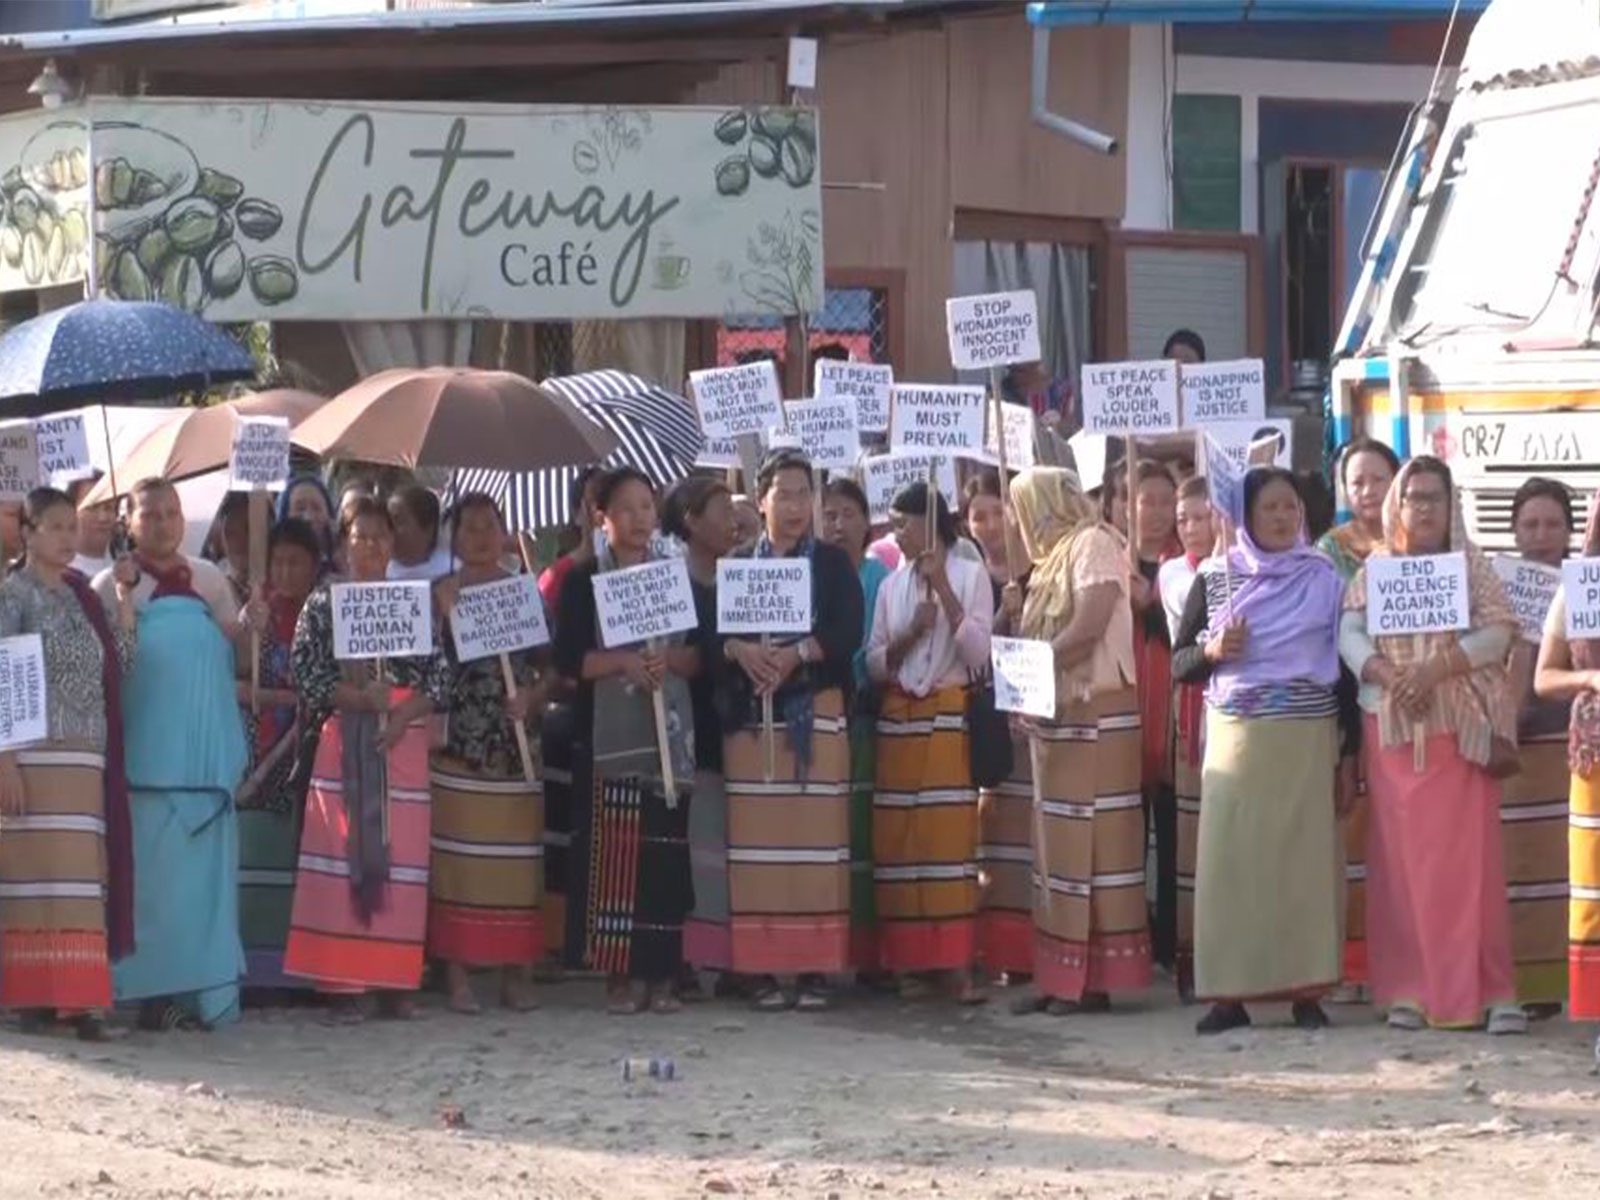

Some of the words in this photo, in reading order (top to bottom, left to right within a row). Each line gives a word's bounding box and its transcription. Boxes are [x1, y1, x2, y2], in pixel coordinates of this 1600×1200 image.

[297, 114, 680, 311] Gateway
[500, 242, 598, 287] Café
[973, 301, 1011, 318] STOP
[954, 314, 1033, 335] KIDNAPPING
[962, 328, 1026, 347] INNOCENT
[970, 343, 1020, 361] PEOPLE
[703, 366, 762, 384] INNOCENT
[822, 367, 845, 379] LET
[848, 369, 889, 384] PEACE
[1091, 370, 1115, 386] LET
[1121, 368, 1166, 384] PEACE
[1180, 371, 1261, 388] KIDNAPPING
[702, 382, 734, 399] LIVES
[738, 377, 768, 391] MUST
[835, 382, 875, 396] SPEAK
[1107, 385, 1153, 399] SPEAK
[1199, 390, 1213, 401] IS
[1215, 387, 1242, 401] NOT
[717, 396, 740, 408] NOT
[897, 391, 981, 406] HUMANITY
[1102, 398, 1159, 414] LOUDER
[704, 403, 777, 424] BARGAINING
[788, 406, 845, 421] OSTAGES
[1194, 401, 1248, 417] JUSTICE
[36, 415, 83, 434] ANITY
[724, 419, 763, 432] TOOLS
[916, 411, 961, 427] MUST
[1092, 414, 1129, 430] THAN
[1134, 412, 1172, 427] GUNS
[774, 424, 798, 437] ARE
[802, 419, 853, 433] HUMANS
[802, 434, 825, 448] NOT
[903, 431, 972, 448] PREVAIL
[804, 445, 845, 459] APONS
[870, 461, 889, 475] WE
[893, 456, 946, 471] DEMAD
[894, 470, 926, 483] SAFE
[607, 565, 672, 587] INNOCENT
[724, 568, 744, 582] WE
[748, 568, 803, 581] DEMAND
[1401, 560, 1435, 577] END
[458, 581, 523, 604] INNOCENT
[604, 584, 642, 602] LIVES
[644, 577, 680, 592] MUST
[747, 582, 780, 595] SAFE
[1377, 575, 1458, 595] VIOLENCE
[343, 586, 419, 603] JUSTICE,
[621, 598, 648, 612] NOT
[651, 594, 668, 606] BE
[734, 596, 793, 609] RELEASE
[1383, 592, 1453, 612] AGAINST
[410, 603, 422, 617] &
[458, 600, 494, 618] LIVES
[497, 594, 530, 609] MUST
[607, 600, 688, 629] BARGAINING
[474, 613, 499, 628] NOT
[503, 609, 520, 621] BE
[721, 610, 806, 623] IMMEDIATELY
[1379, 608, 1458, 630] CIVILIANS
[350, 621, 413, 637] HUMAN
[461, 616, 540, 644] BARGAINING
[629, 620, 672, 636] TOOLS
[348, 637, 417, 653] DIGNITY
[482, 634, 524, 650] TOOLS
